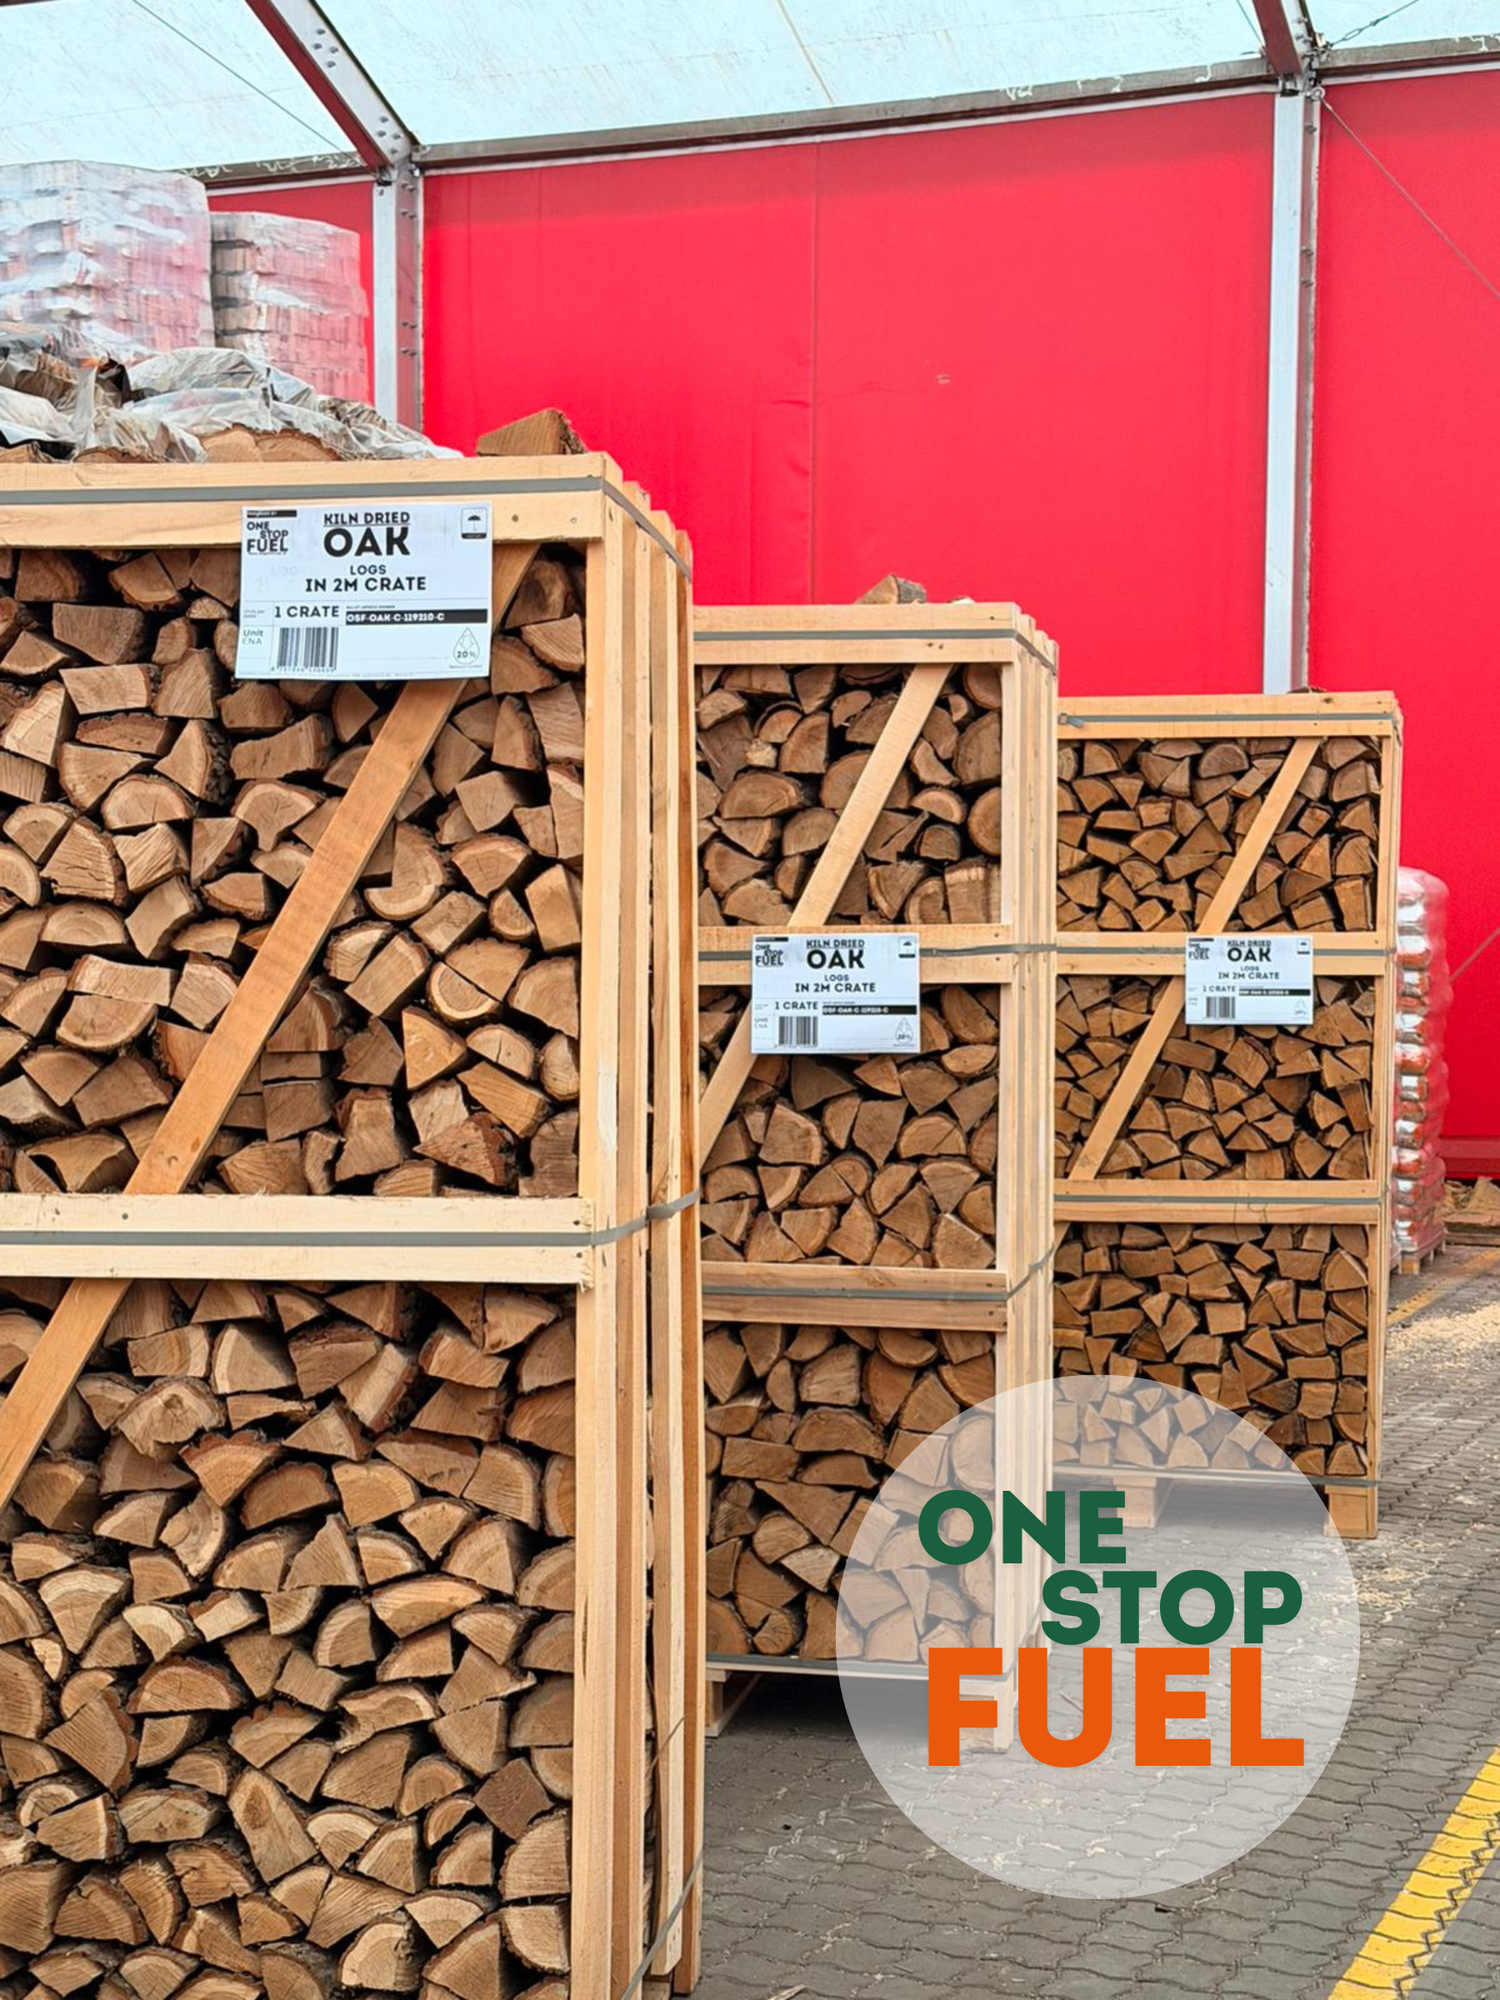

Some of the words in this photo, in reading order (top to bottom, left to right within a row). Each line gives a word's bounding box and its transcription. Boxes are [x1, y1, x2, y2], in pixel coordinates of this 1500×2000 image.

[324, 513, 358, 524] KILN
[364, 512, 410, 523] DRIED
[247, 521, 270, 531] ONE
[260, 530, 289, 540] STOP
[247, 539, 289, 552] FUEL
[324, 527, 410, 557] OAK
[350, 565, 387, 575] LOGS
[306, 578, 326, 592] IN
[333, 578, 358, 592] 2M
[364, 577, 427, 591] CRATE
[275, 606, 281, 618] 1
[286, 605, 339, 618] CRATE
[806, 939, 831, 949] KILN
[834, 939, 865, 948] DRIED
[807, 949, 865, 969] OAK
[1227, 947, 1272, 962] OAK
[755, 956, 784, 966] FUEL
[824, 974, 849, 982] LOGS
[1218, 972, 1229, 980] IN
[1232, 972, 1246, 980] 2M
[1248, 972, 1280, 980] CRATE
[795, 983, 809, 993] IN
[814, 983, 830, 993] 2M
[834, 982, 876, 993] CRATE
[775, 1001, 780, 1010] 1
[783, 1001, 818, 1010] CRATE
